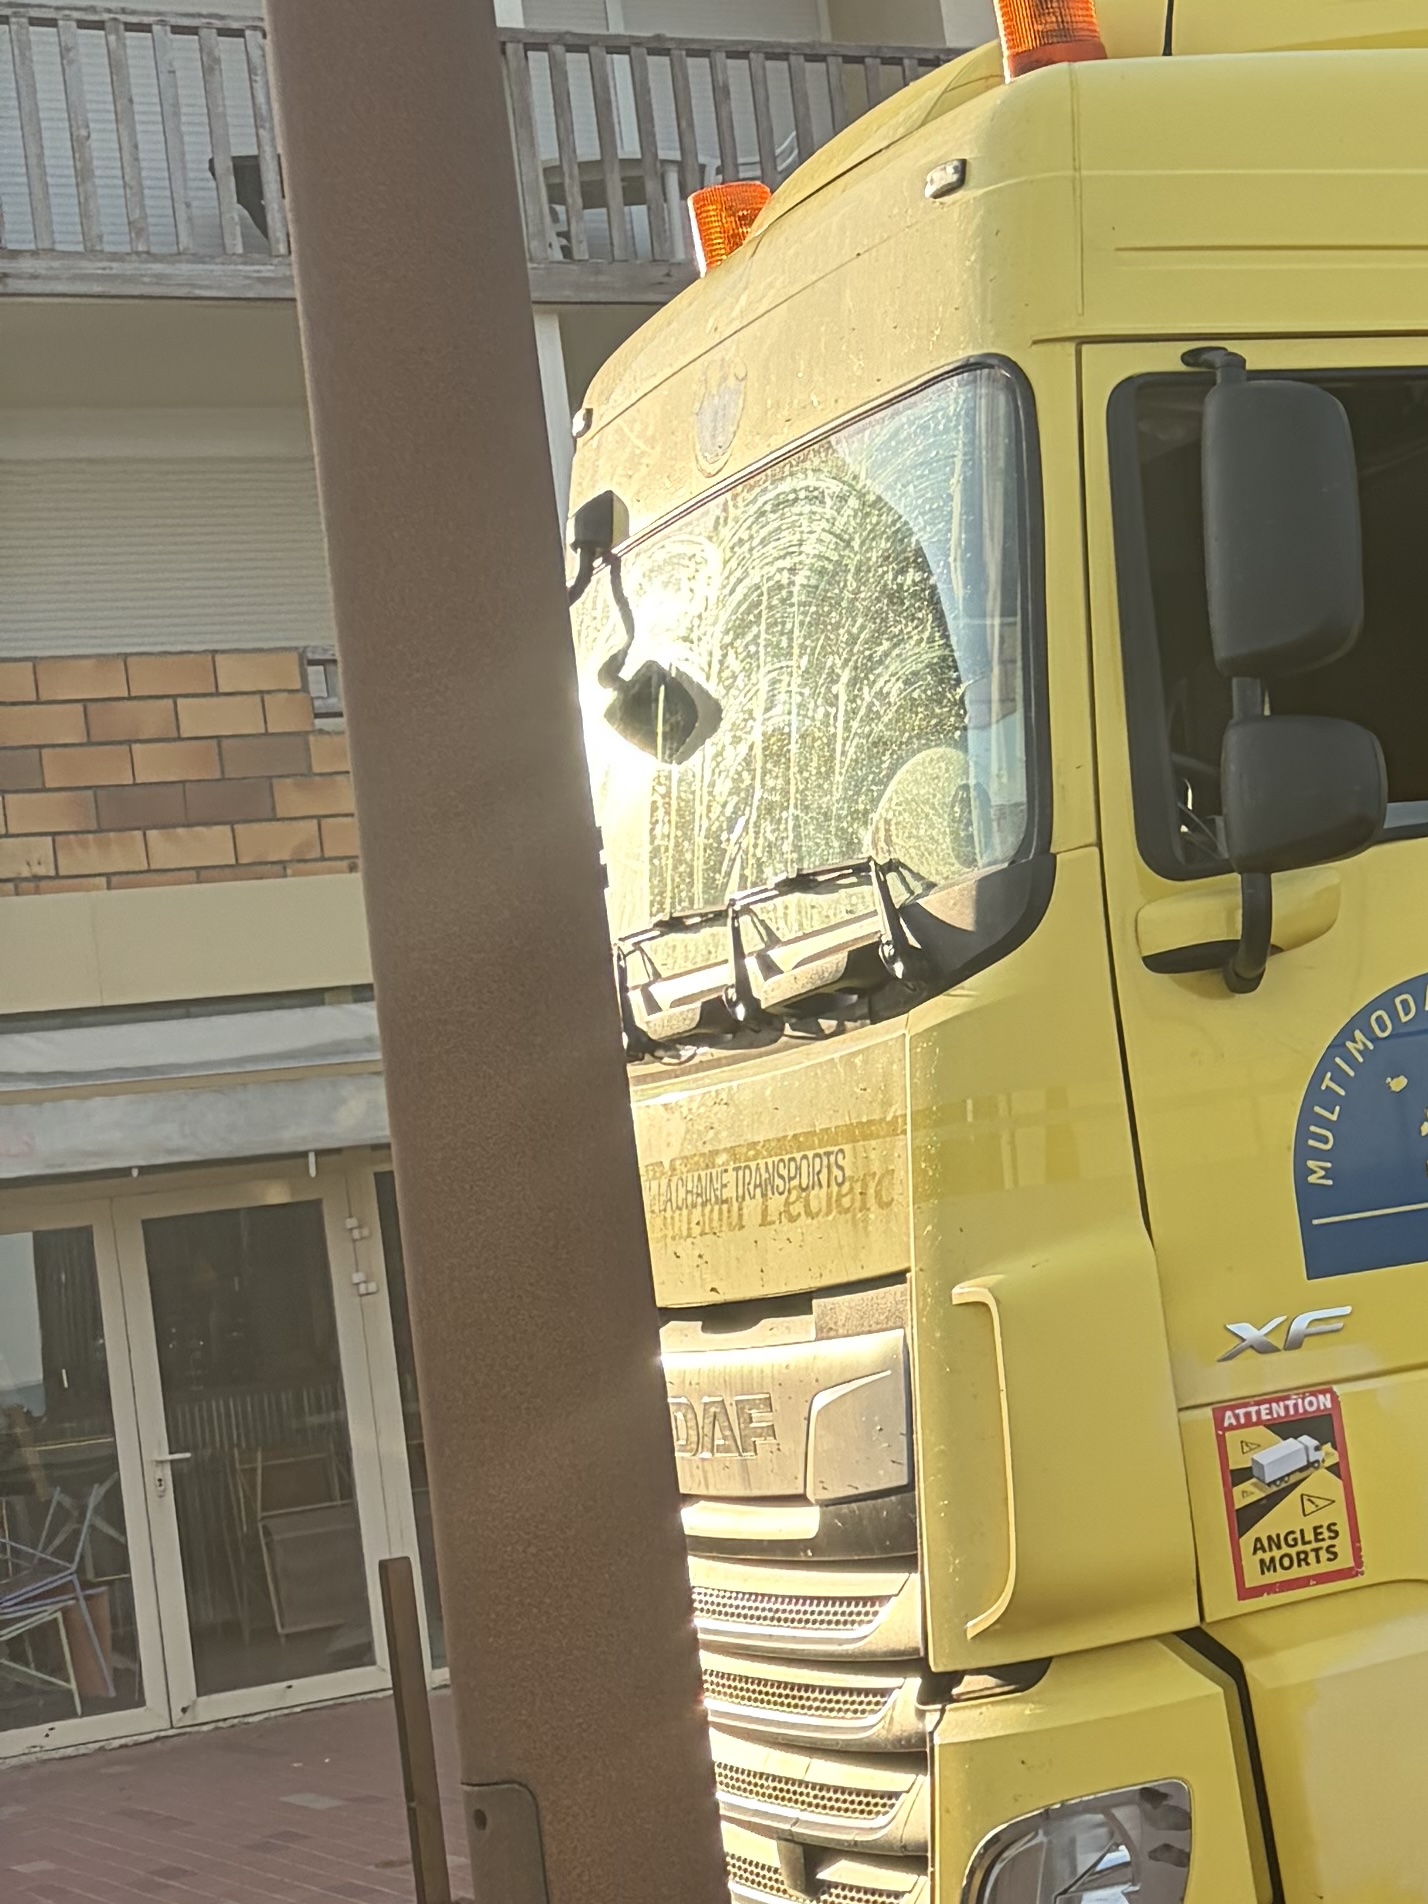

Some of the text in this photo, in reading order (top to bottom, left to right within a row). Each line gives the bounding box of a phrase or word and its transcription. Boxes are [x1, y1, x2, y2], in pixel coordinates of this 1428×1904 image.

[732, 1148, 847, 1202] TRANSPORTS
[1216, 1306, 1353, 1362] XF
[667, 1392, 778, 1458] DAF
[1222, 1393, 1333, 1428] ATTENTION
[1251, 1522, 1341, 1556] ANGLES
[1258, 1543, 1340, 1576] MORTS
